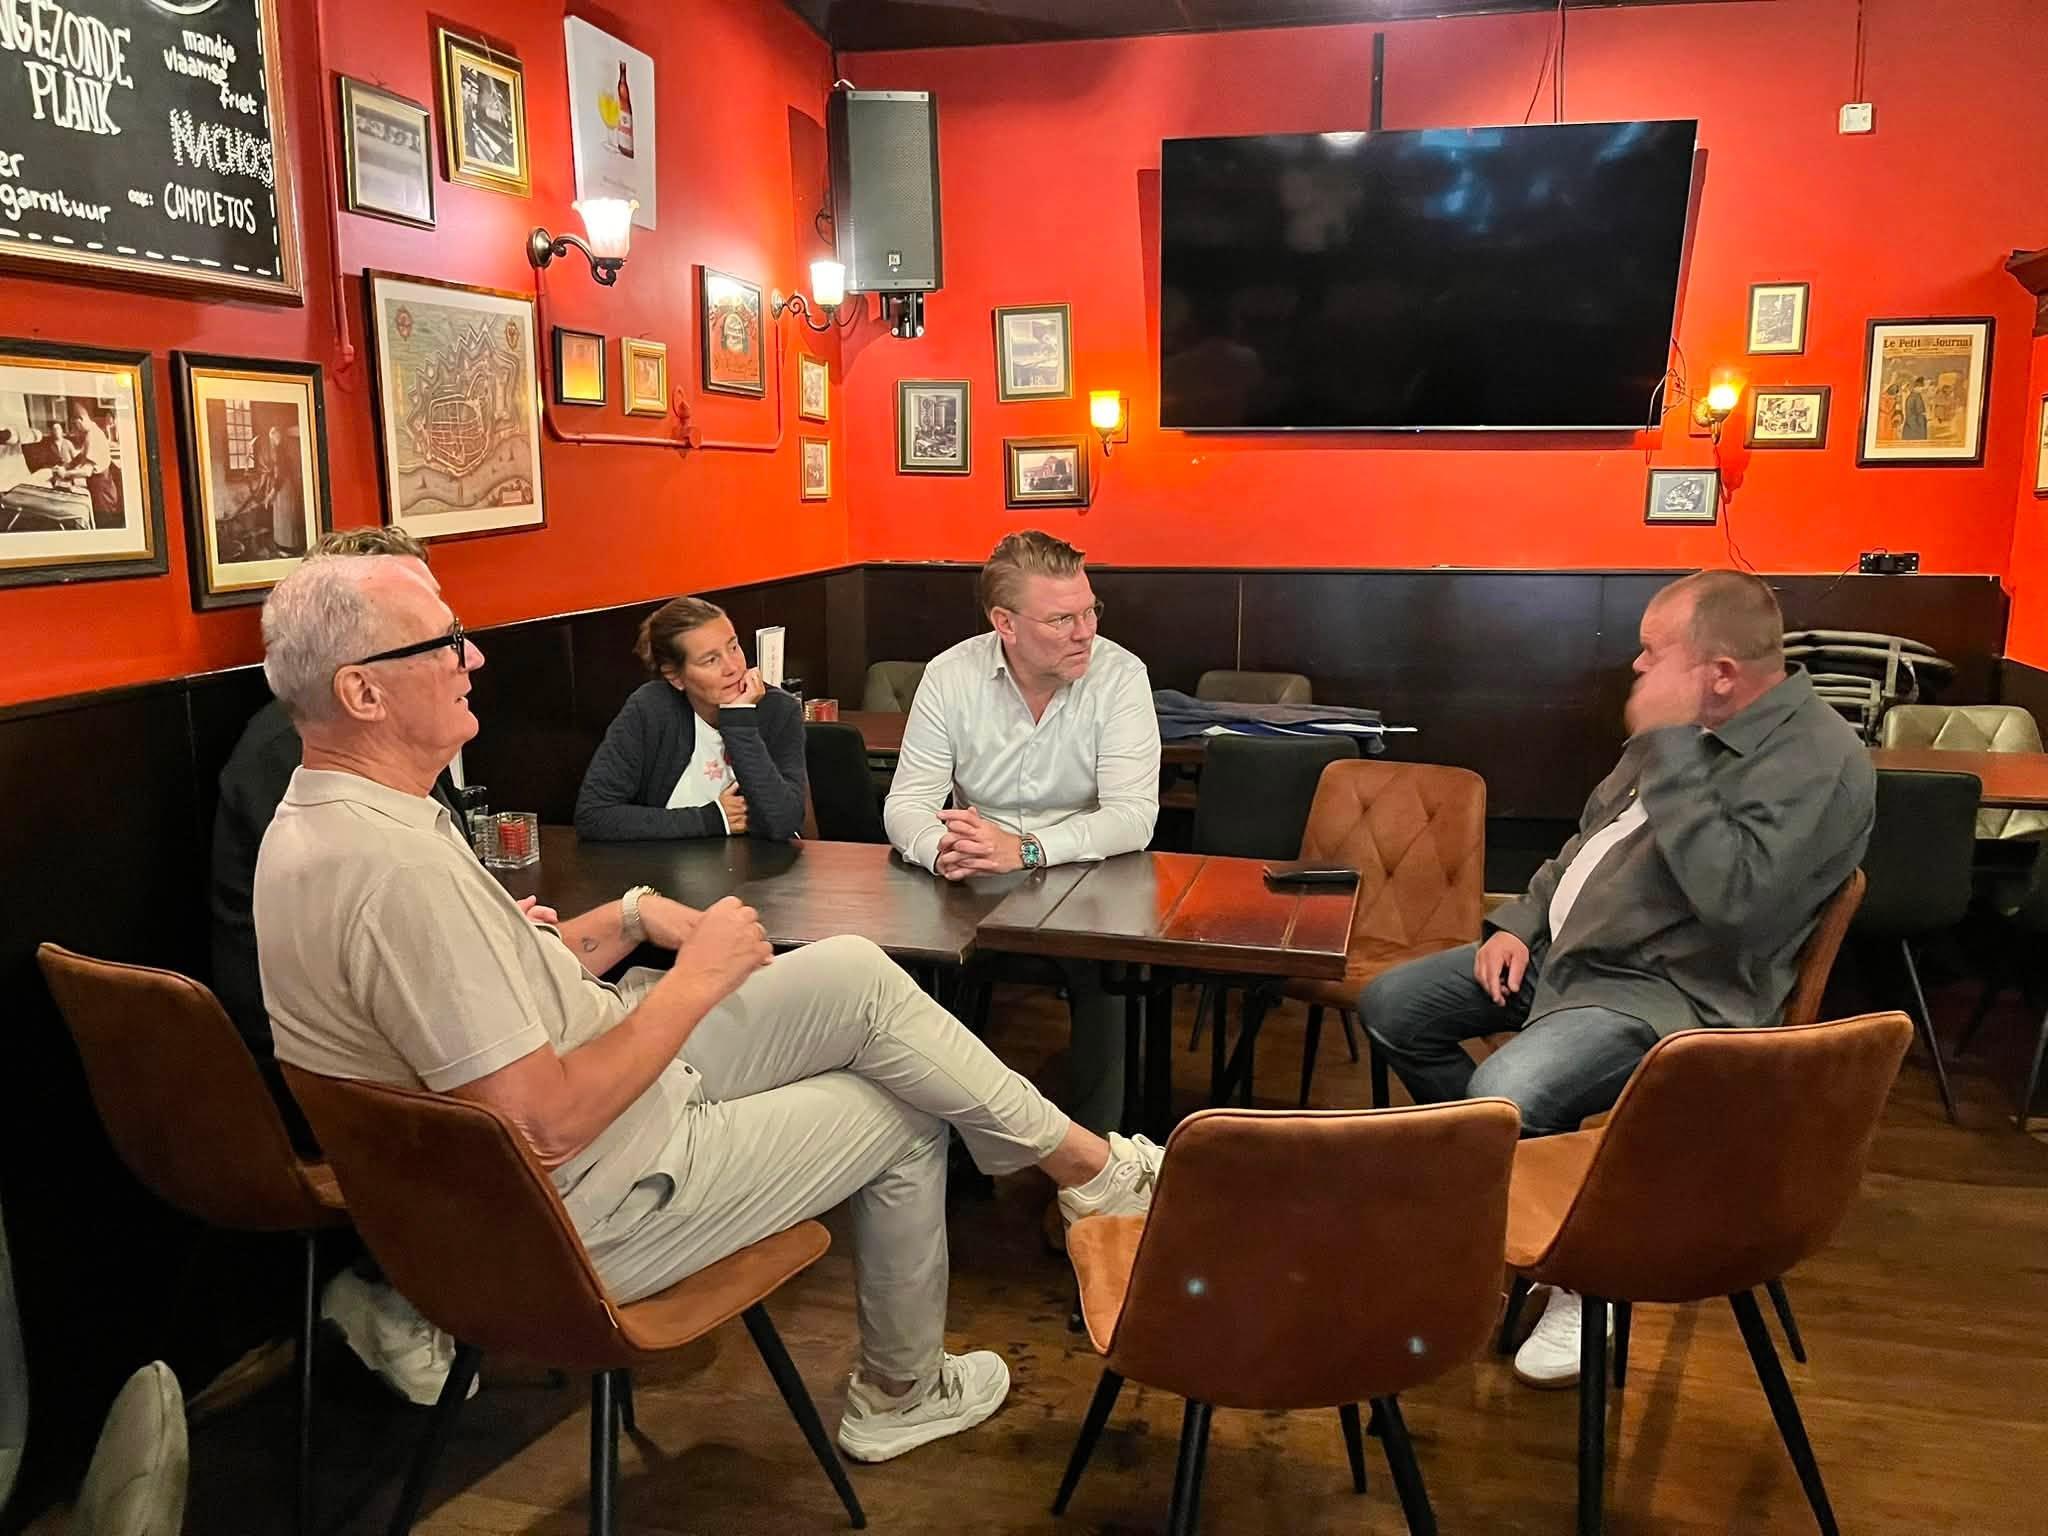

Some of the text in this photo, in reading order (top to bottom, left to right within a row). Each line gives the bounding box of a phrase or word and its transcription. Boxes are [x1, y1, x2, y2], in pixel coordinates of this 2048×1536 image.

[163, 45, 228, 84] vlaamse
[182, 30, 237, 69] mandje
[23, 61, 122, 135] PLANK
[219, 81, 258, 115] friet
[169, 108, 274, 188] NACHOS
[163, 181, 257, 235] COMPLETOS
[1883, 336, 1973, 349] Le Petit Journal
